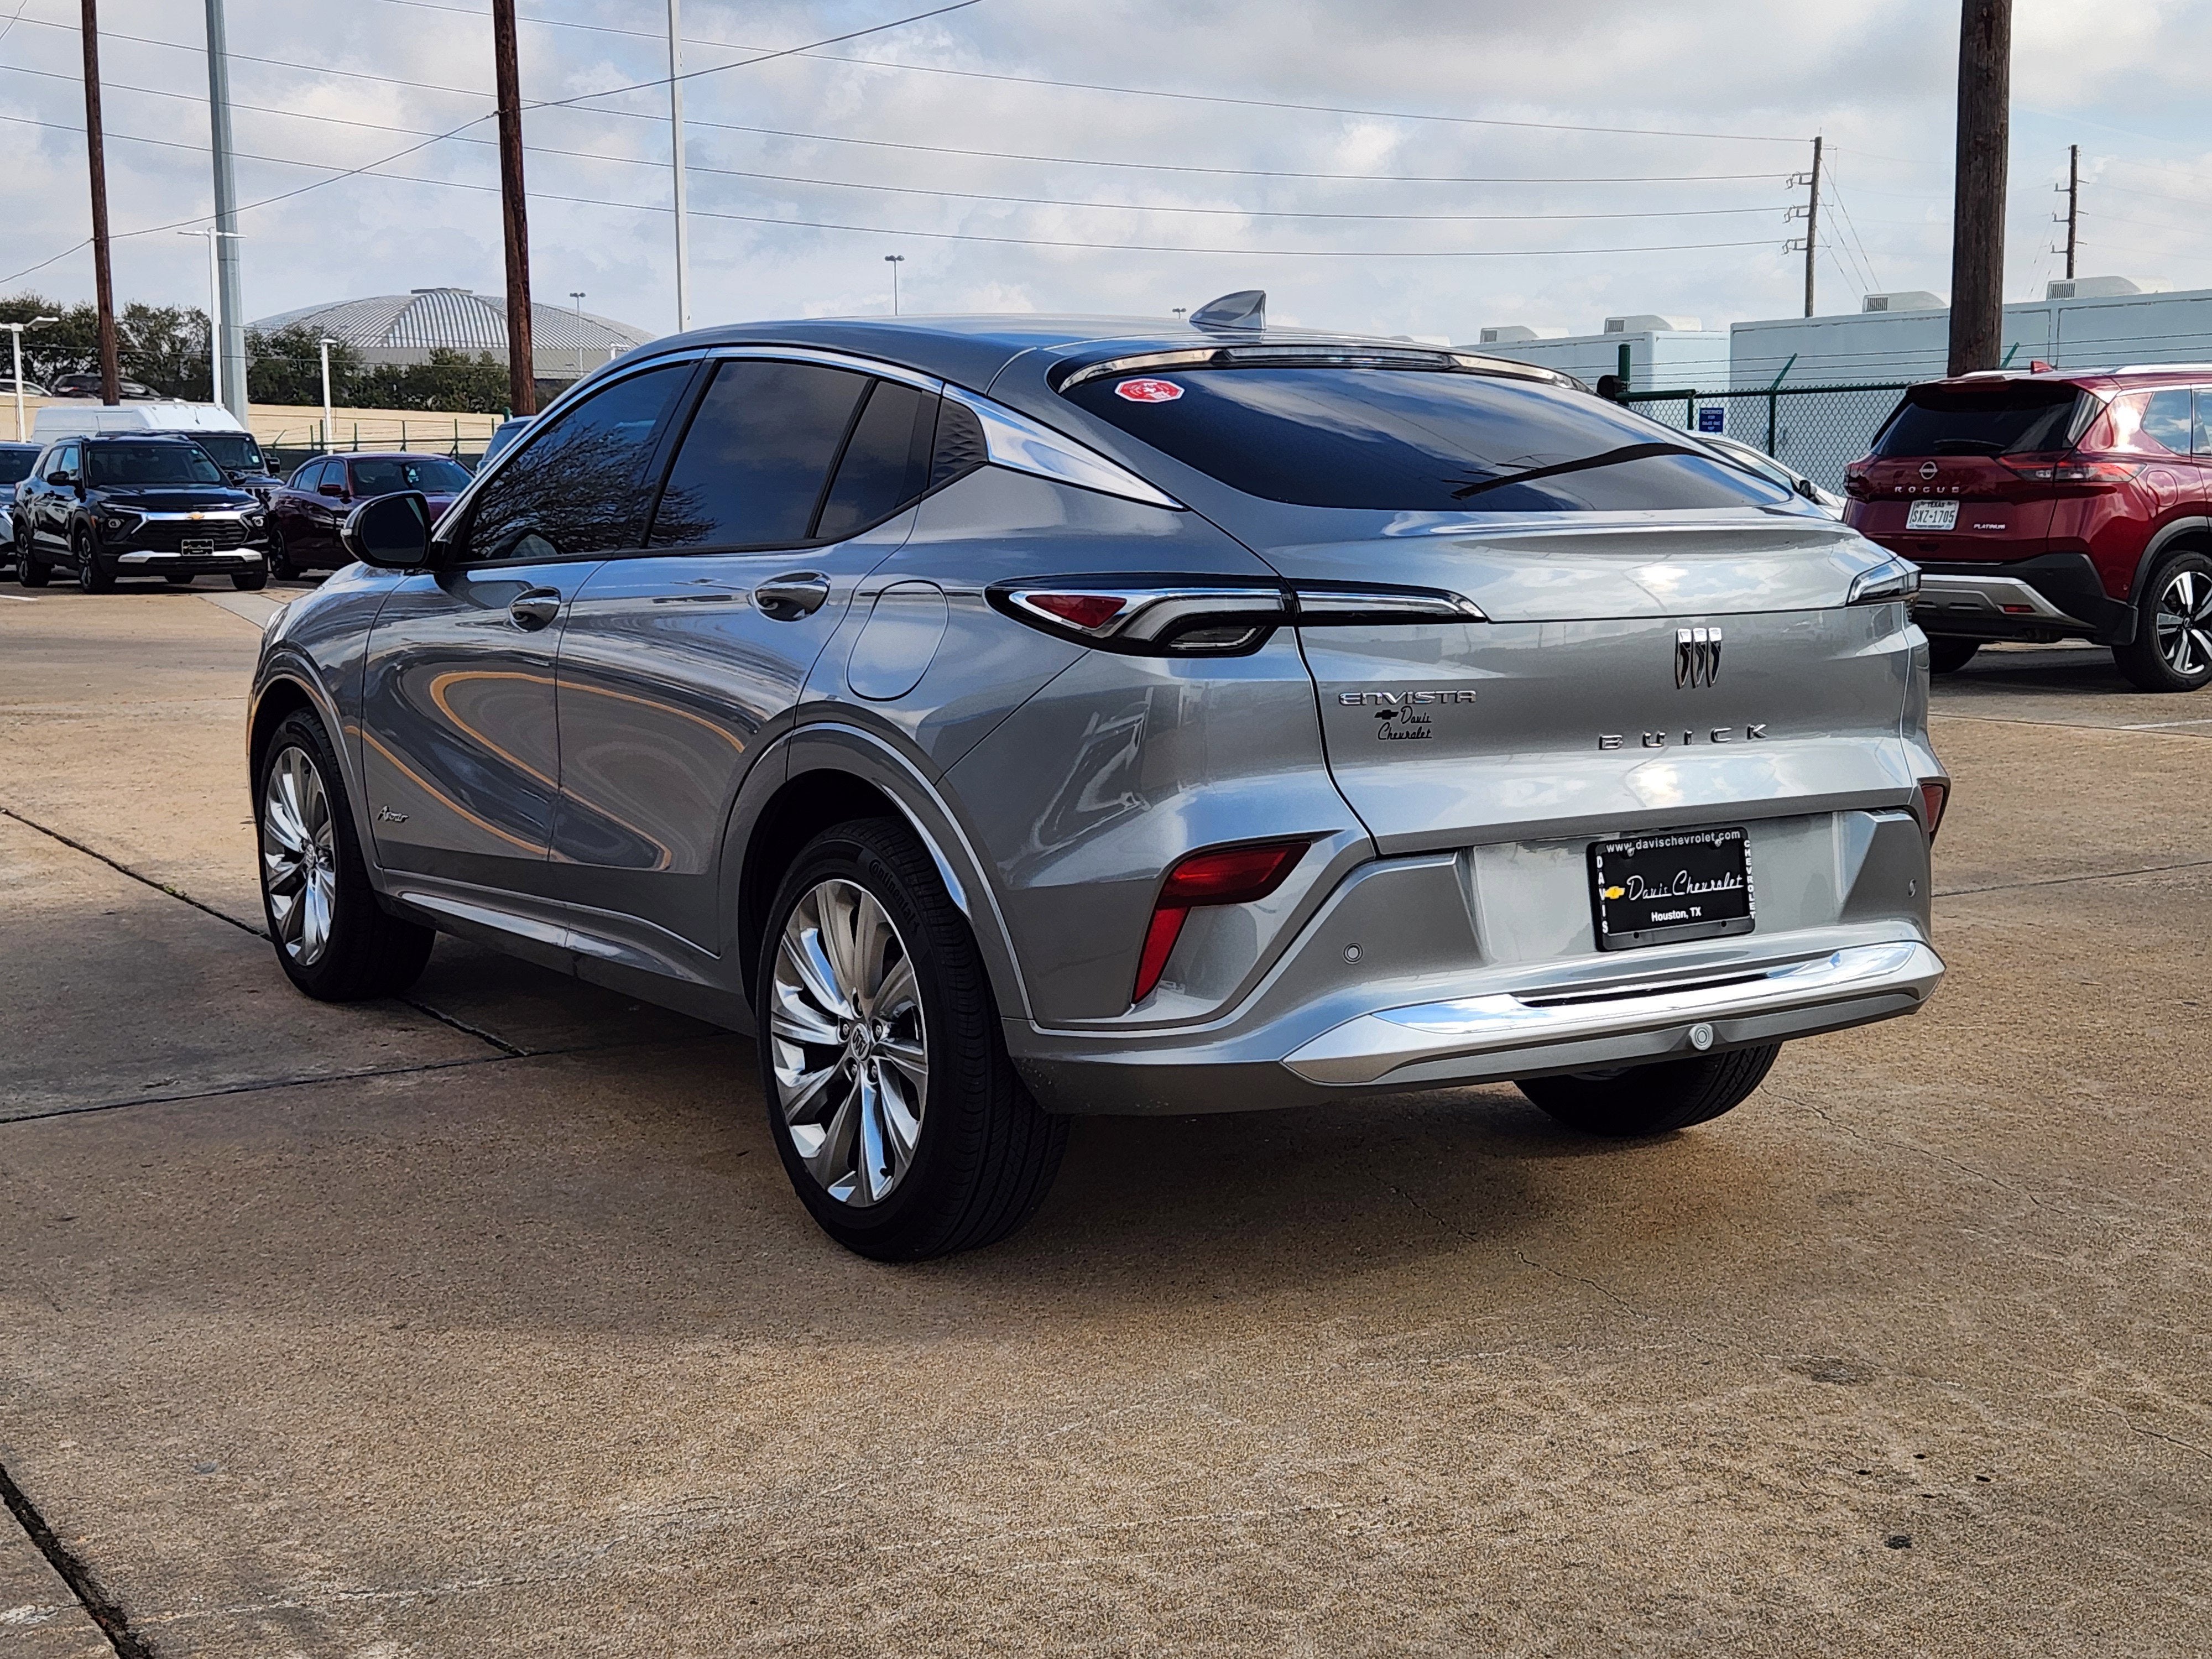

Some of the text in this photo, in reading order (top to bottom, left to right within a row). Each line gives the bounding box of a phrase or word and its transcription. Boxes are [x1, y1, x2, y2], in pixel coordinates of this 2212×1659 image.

[1339, 690, 1477, 706] ENVISTA
[1401, 706, 1432, 724] Davis
[1378, 722, 1432, 740] Chevrolet
[1599, 724, 1768, 750] BUICK
[1606, 831, 1741, 853] www.davischevrolet.com
[1626, 870, 1744, 901] Davis Chevrolet
[1744, 839, 1756, 920] CHEVROLET
[869, 859, 916, 925] Continental
[1597, 855, 1609, 933] DAVIS
[1651, 906, 1702, 922] Houston, TX
